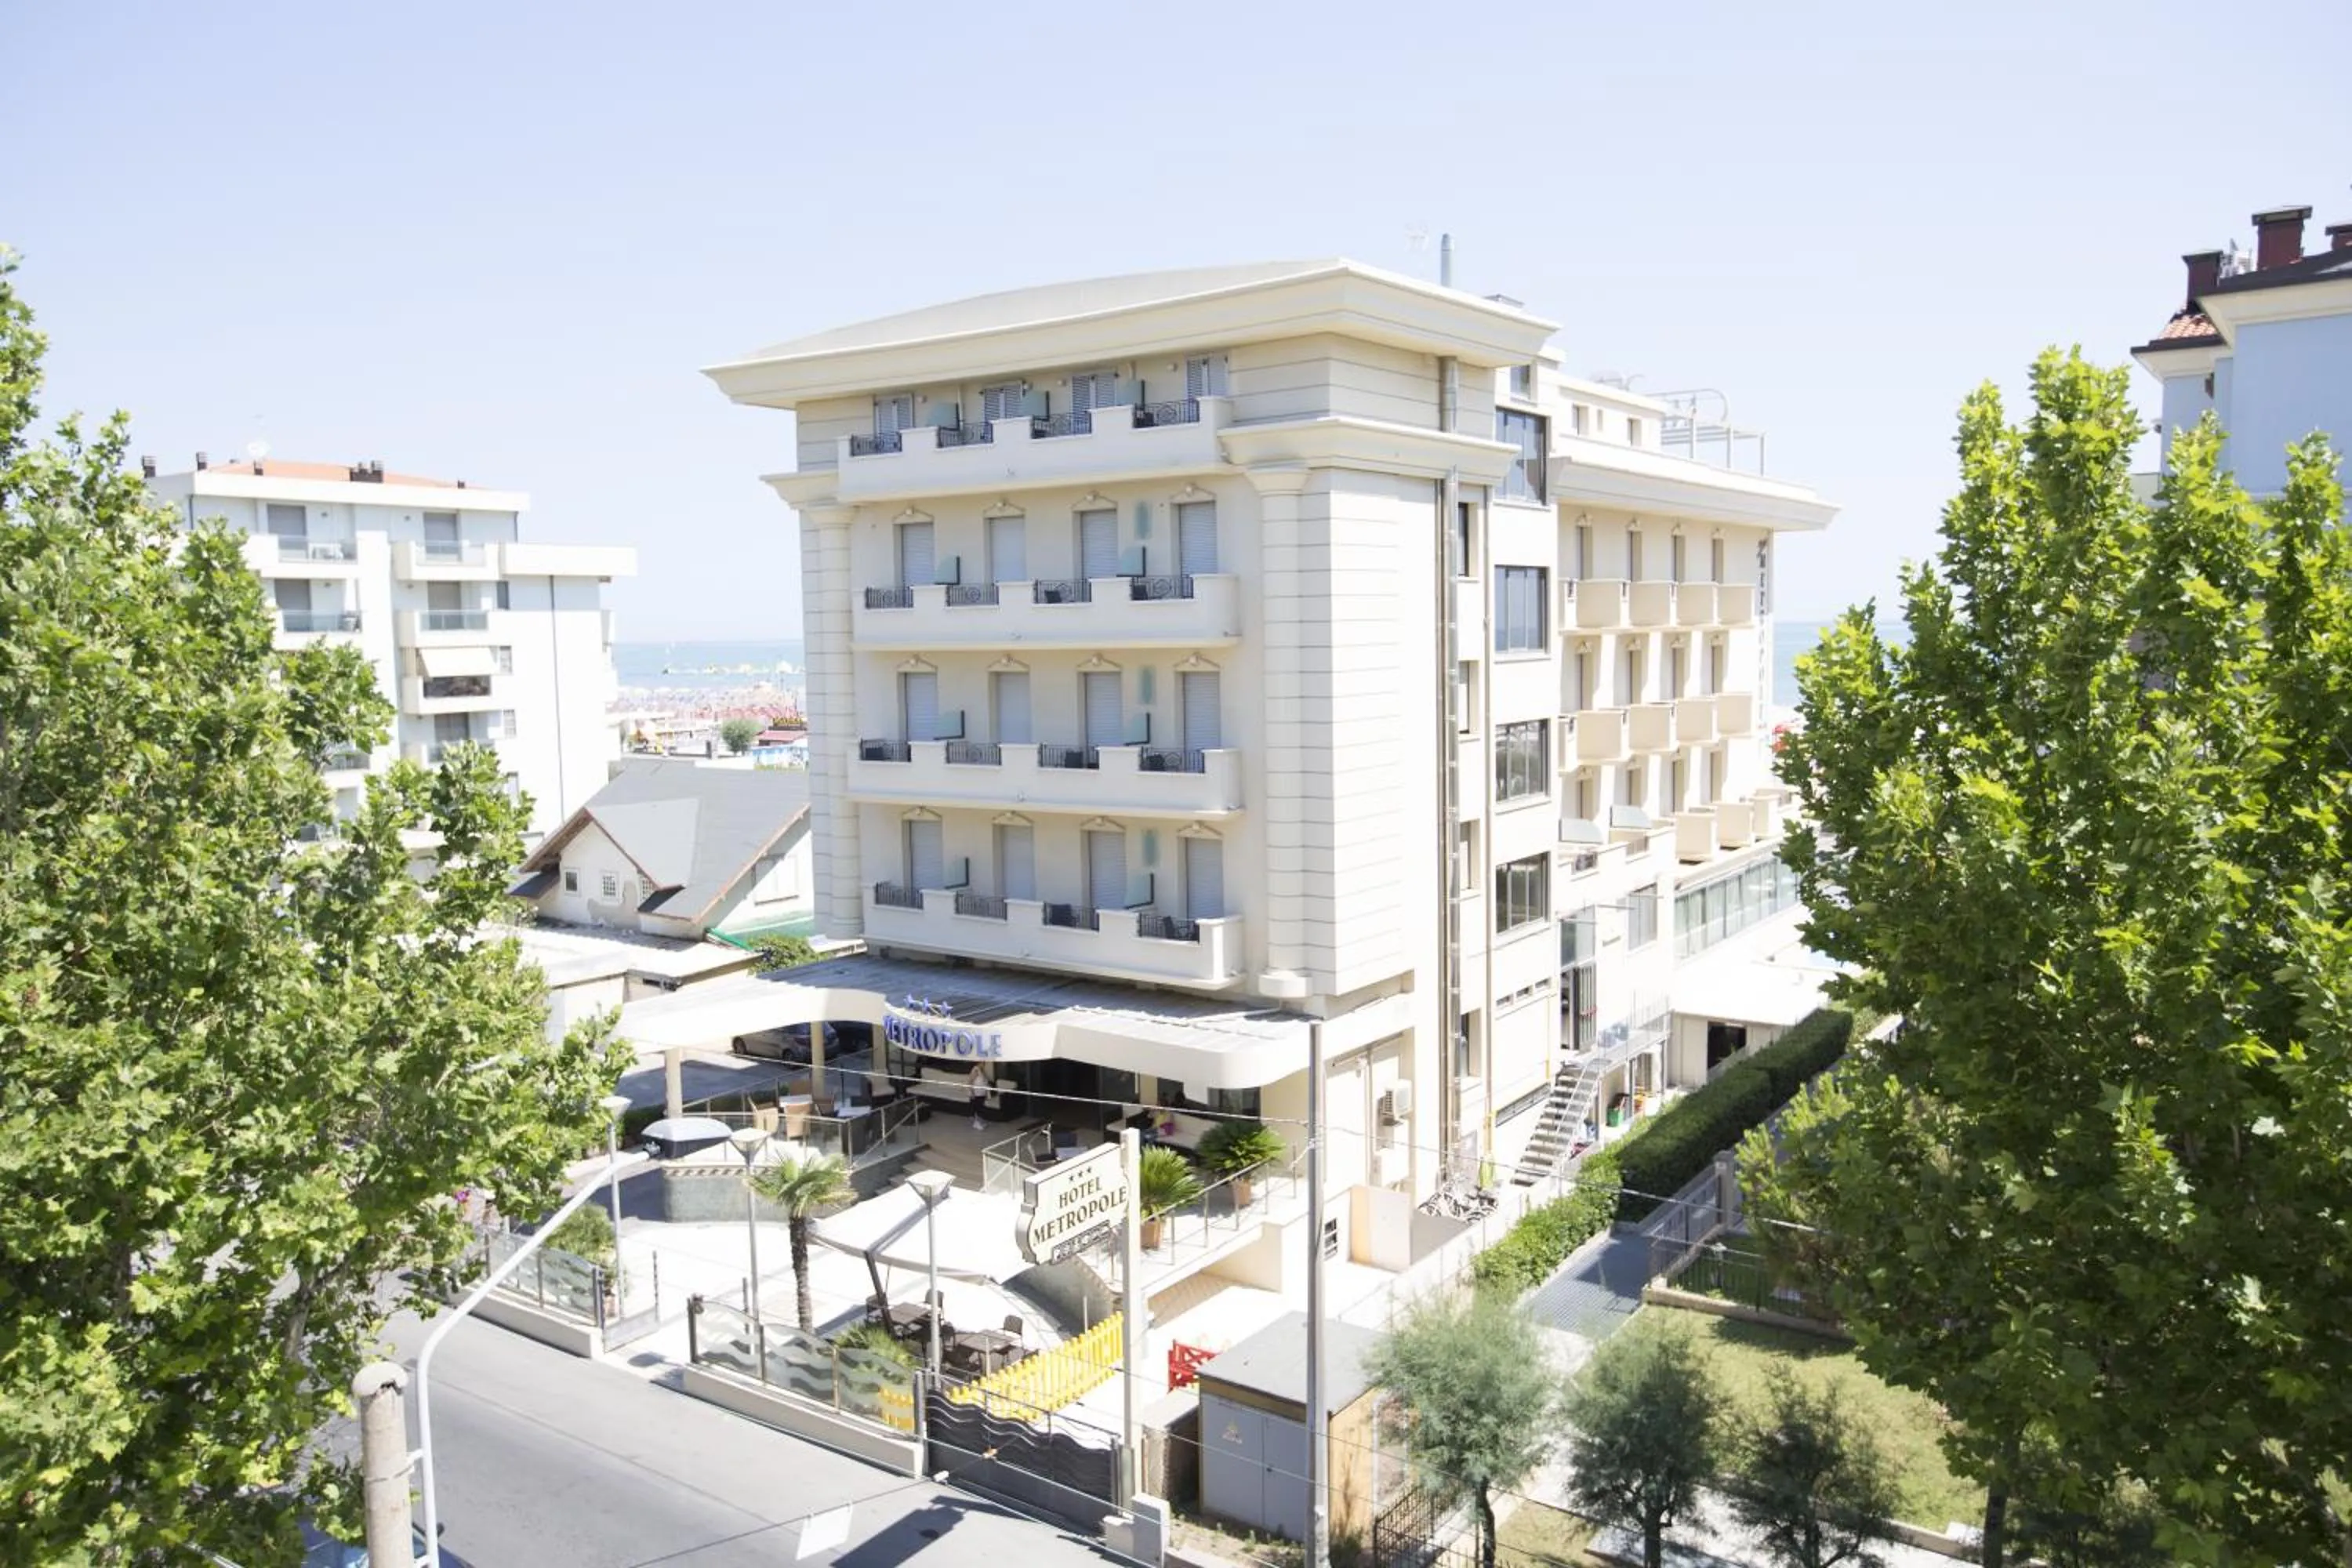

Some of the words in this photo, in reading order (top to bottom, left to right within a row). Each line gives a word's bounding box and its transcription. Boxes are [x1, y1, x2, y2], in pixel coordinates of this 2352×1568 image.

[883, 1014, 1003, 1057] METROPOLE
[1058, 1177, 1102, 1209] HOTEL
[1033, 1186, 1127, 1247] METROPOLE
